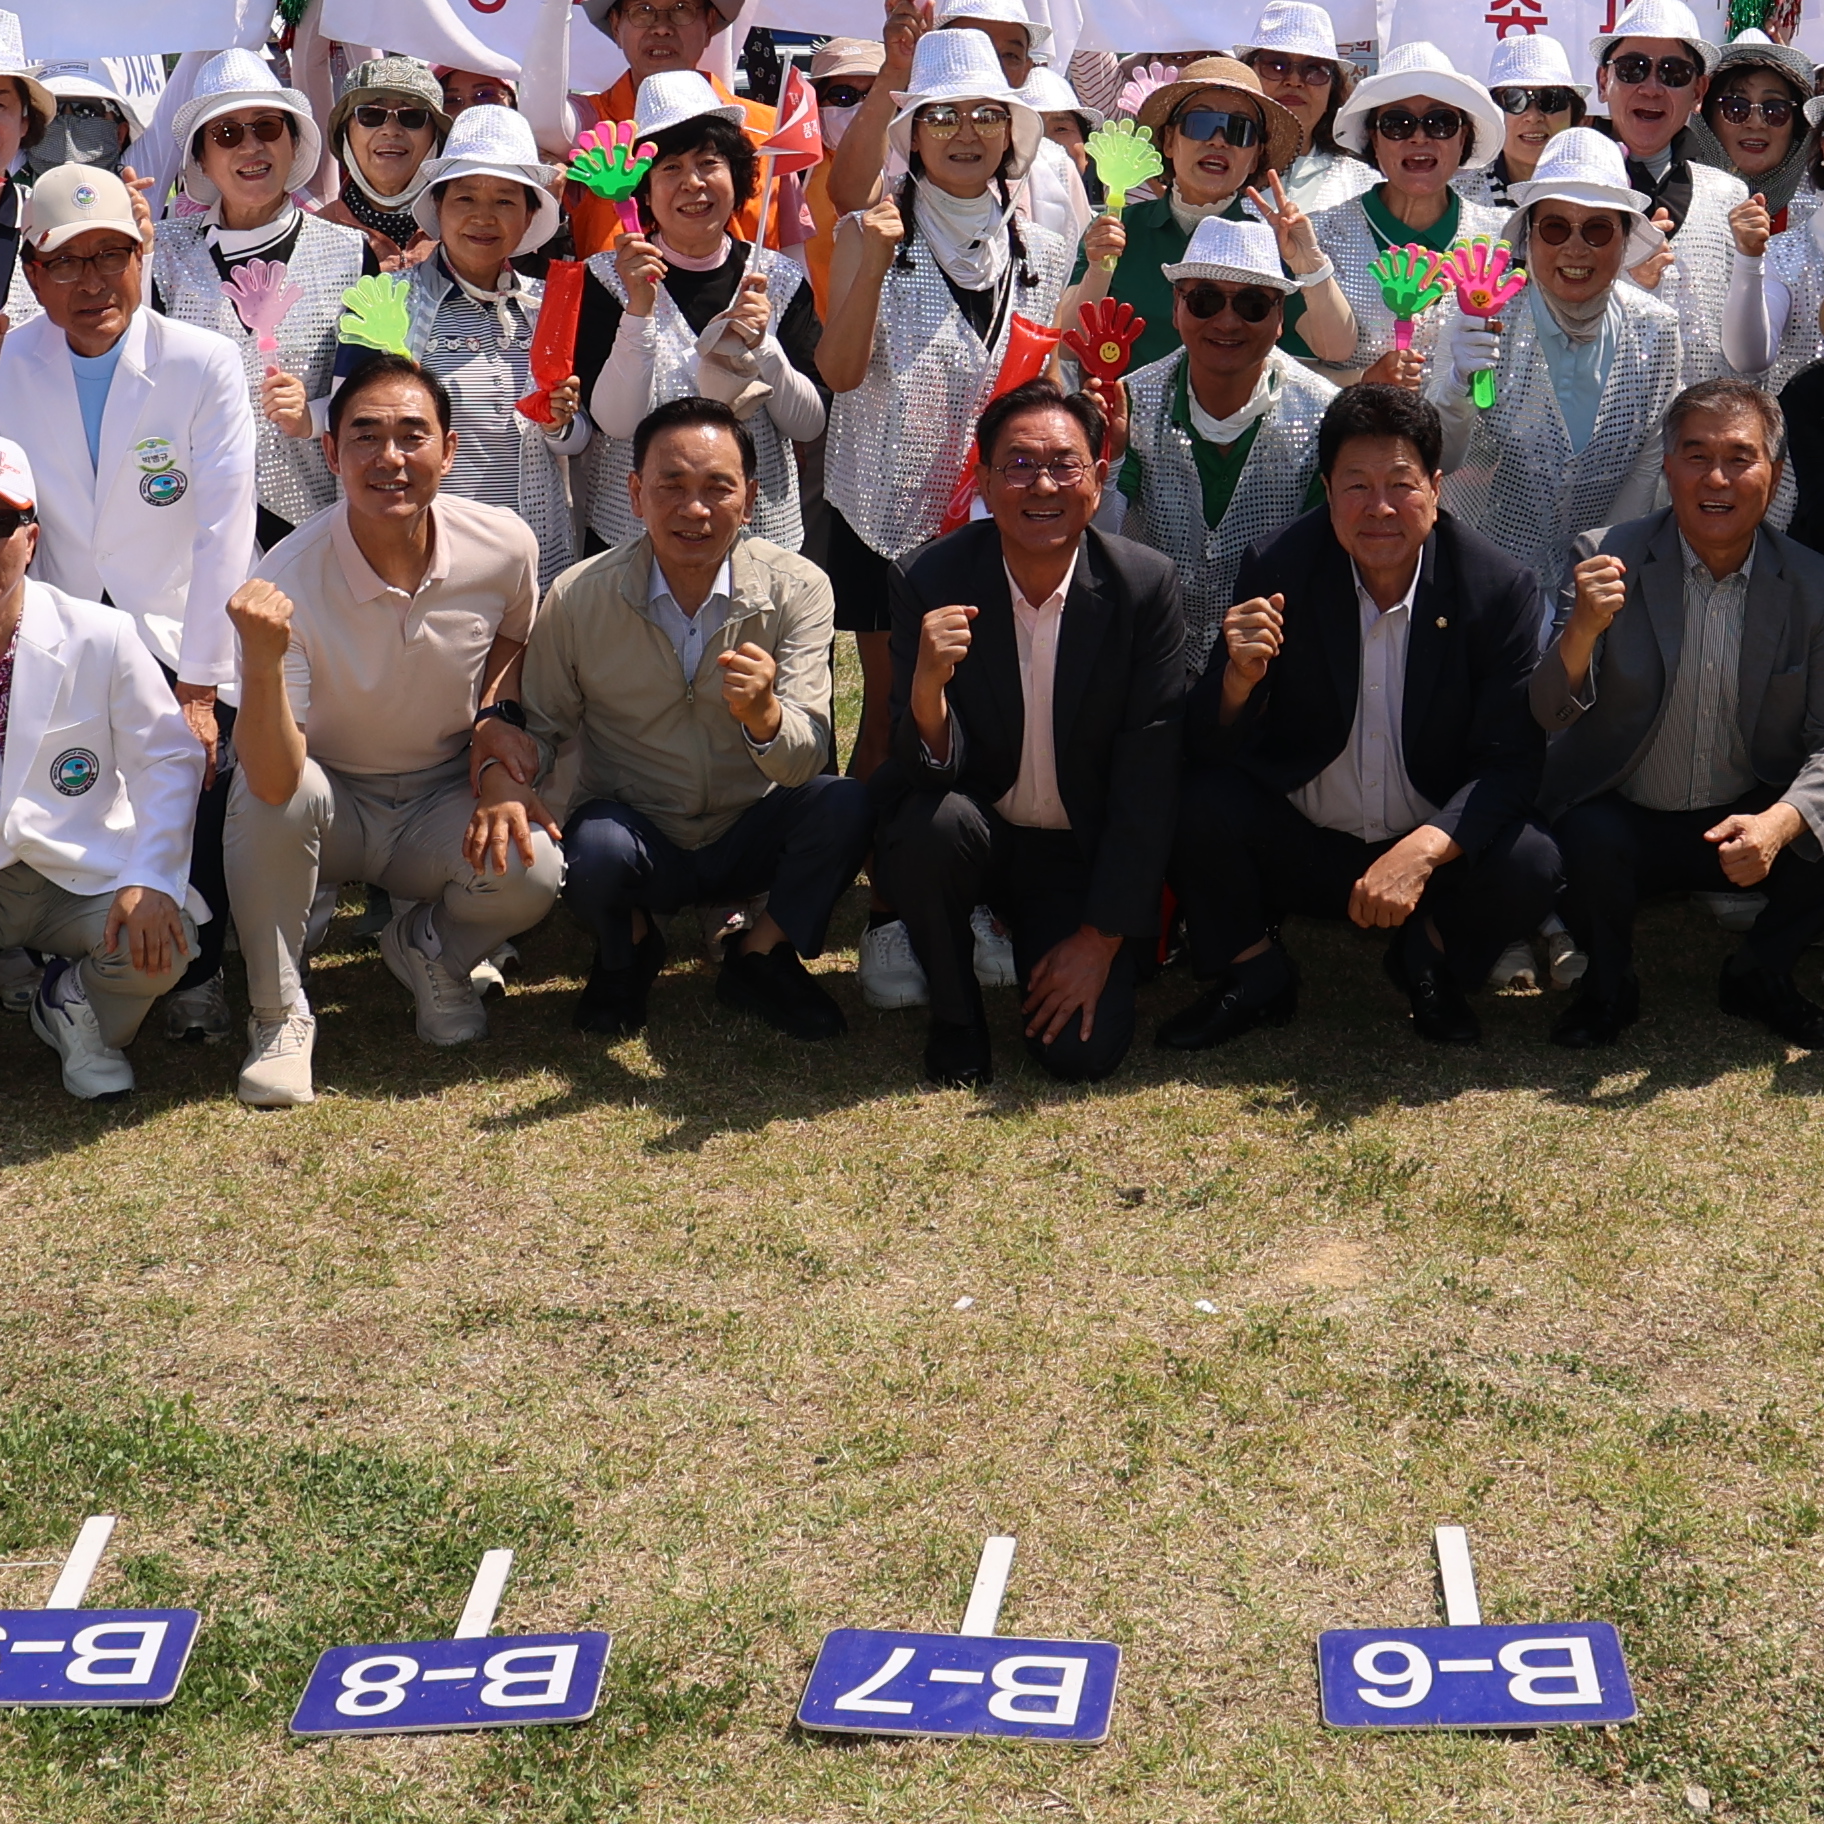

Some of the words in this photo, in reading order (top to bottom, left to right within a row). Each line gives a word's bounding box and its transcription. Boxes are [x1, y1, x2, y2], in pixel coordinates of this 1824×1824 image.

[334, 1643, 580, 1717] B-8
[832, 1646, 1089, 1727] B-7
[1351, 1635, 1604, 1710] B-6
